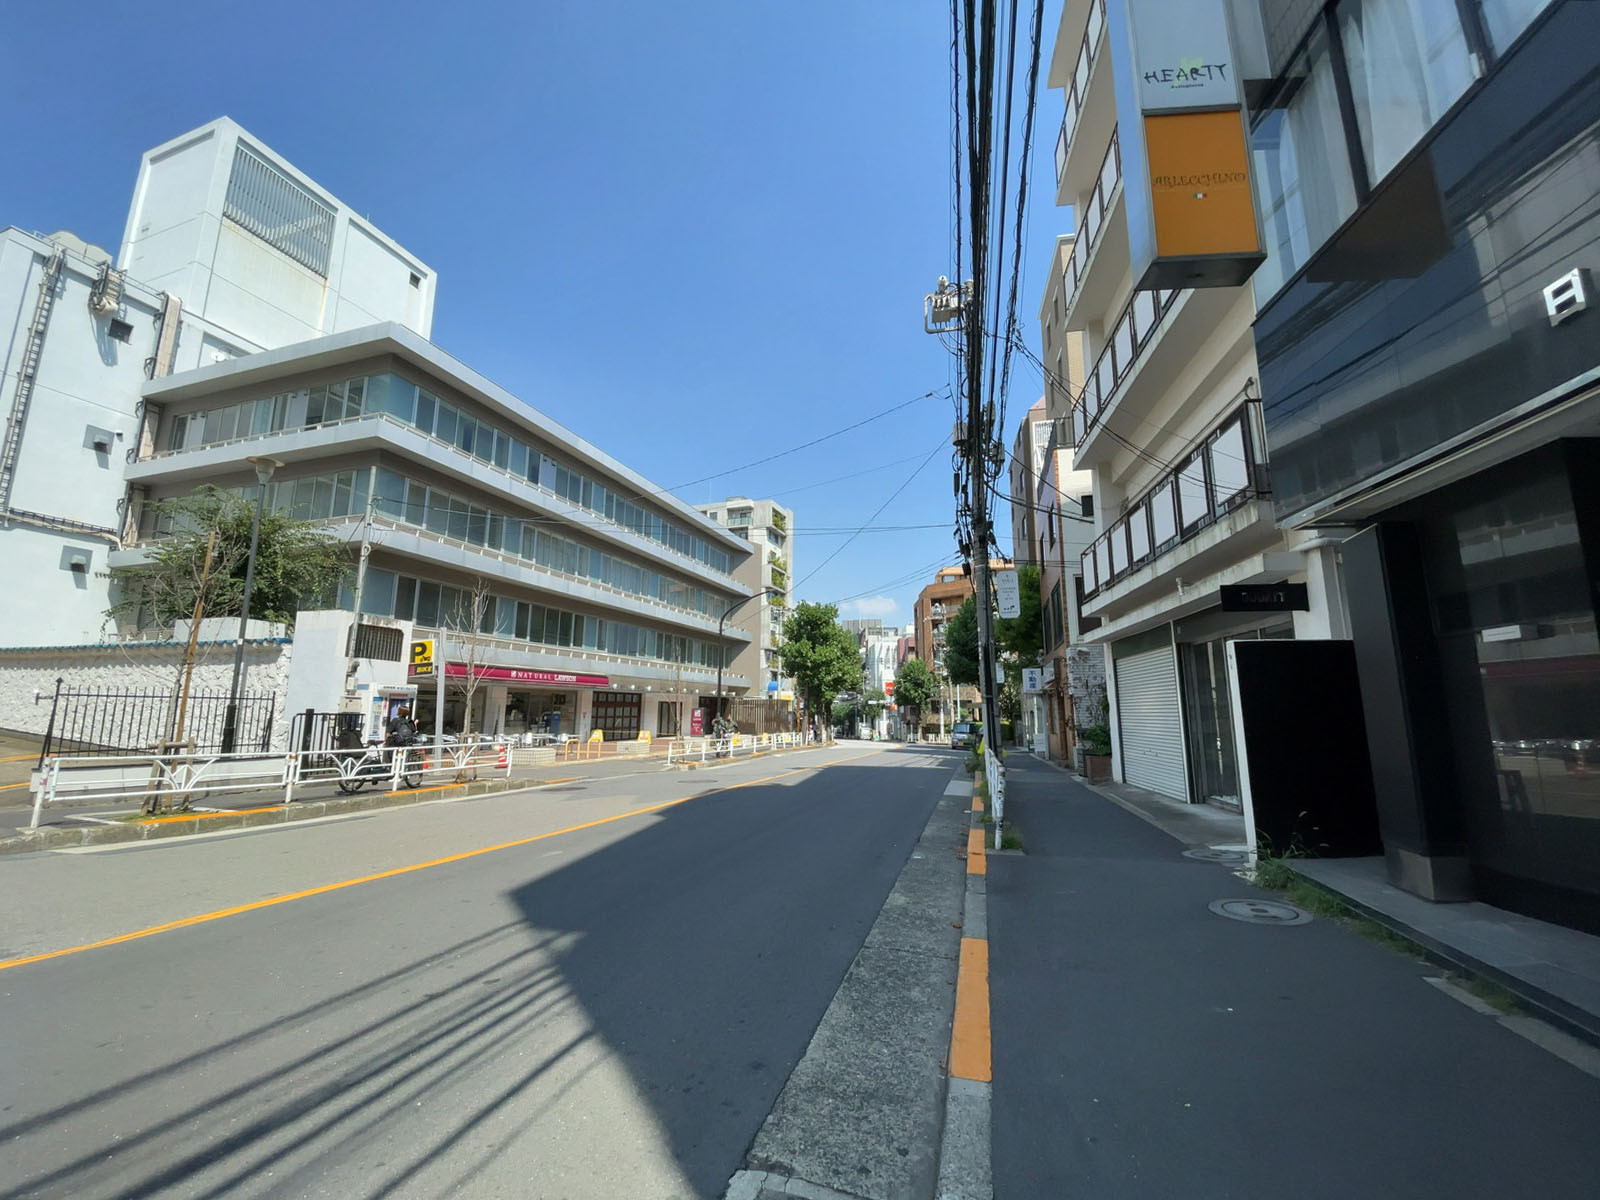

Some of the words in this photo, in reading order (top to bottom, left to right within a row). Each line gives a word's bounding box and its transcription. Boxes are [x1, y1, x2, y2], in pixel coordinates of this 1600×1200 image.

[410, 642, 427, 663] P
[517, 671, 552, 681] NATURAL
[554, 674, 577, 682] LAWSON
